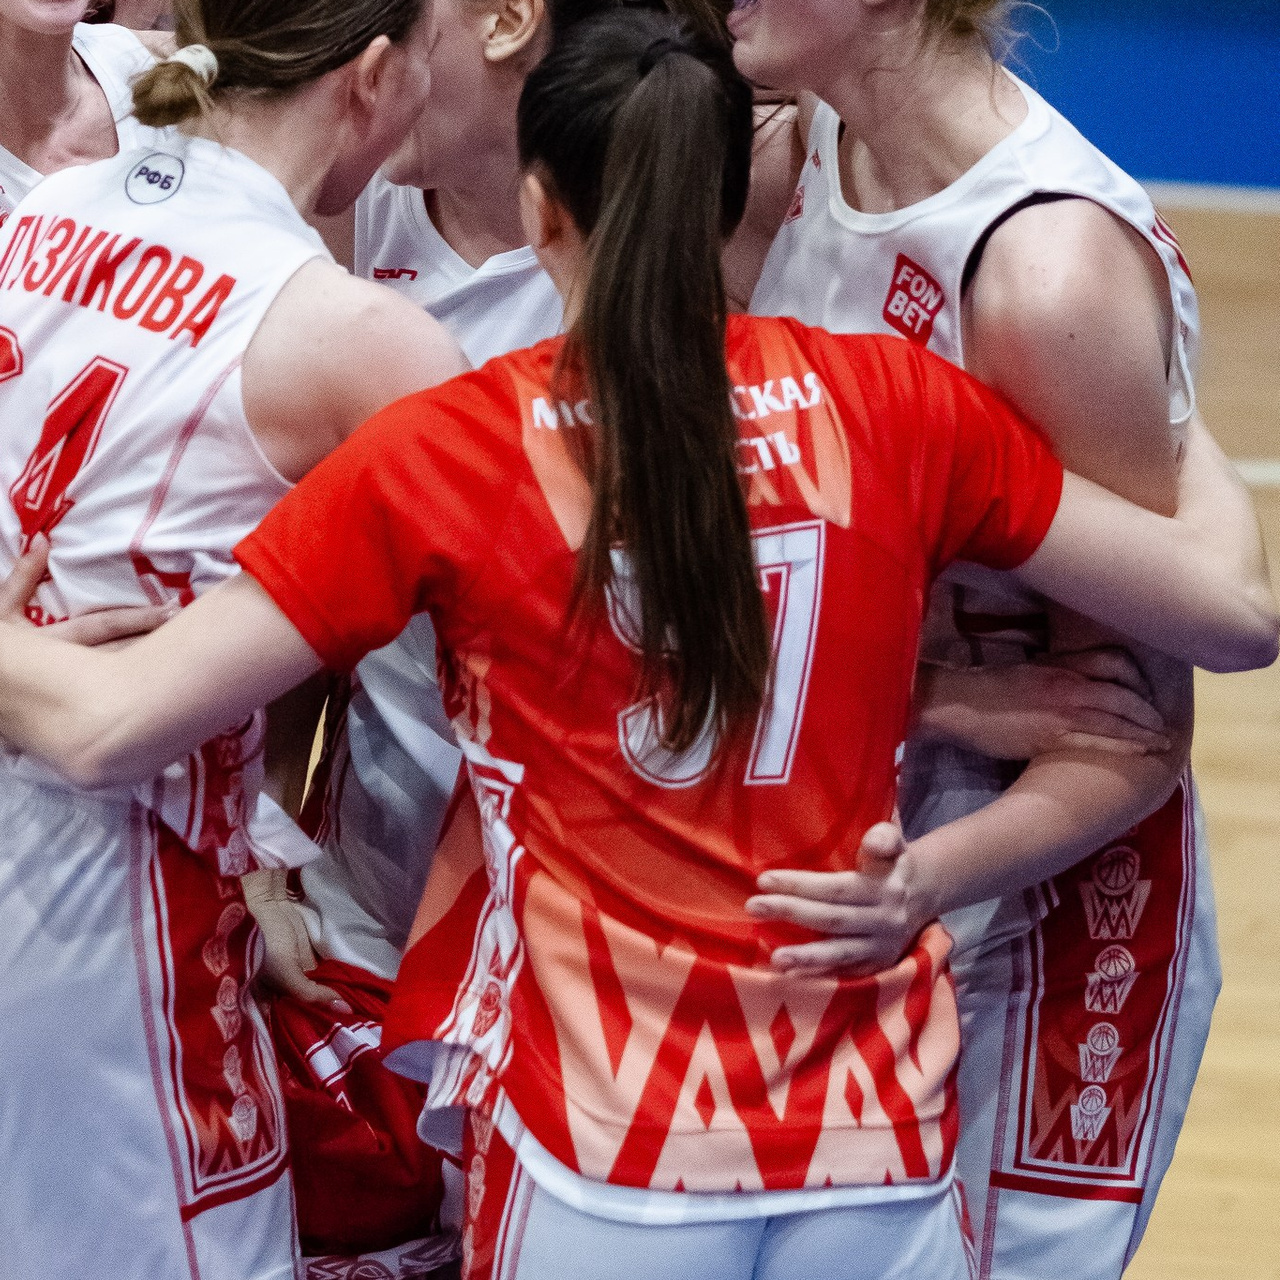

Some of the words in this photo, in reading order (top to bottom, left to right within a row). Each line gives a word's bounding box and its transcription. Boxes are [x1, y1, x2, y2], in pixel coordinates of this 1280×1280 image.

[134, 165, 175, 190] РФБ
[896, 264, 942, 311] FON
[887, 289, 932, 334] BET
